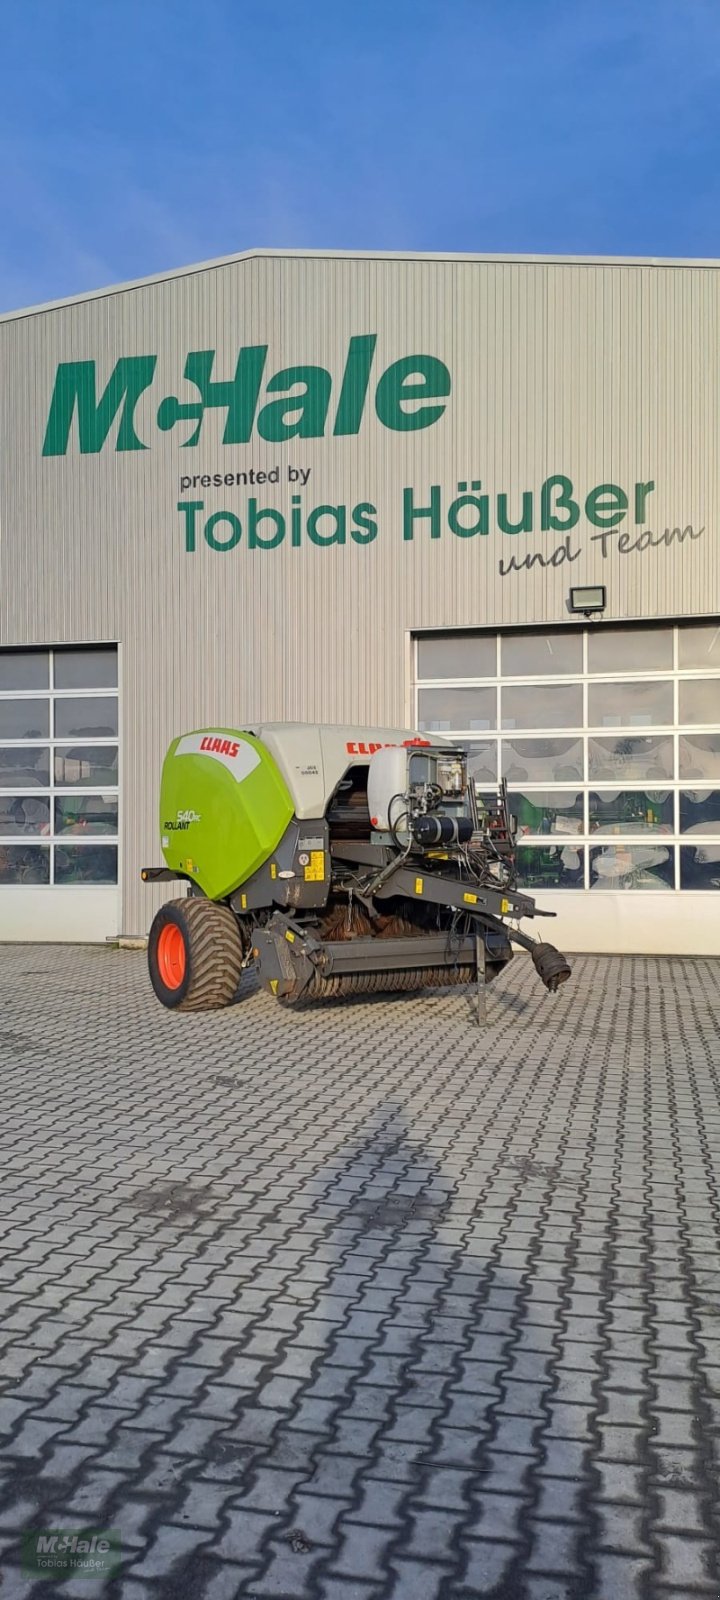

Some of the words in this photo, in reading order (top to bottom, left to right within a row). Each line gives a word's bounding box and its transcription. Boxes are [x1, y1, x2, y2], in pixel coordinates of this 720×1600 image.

[41, 333, 452, 457] McHale
[180, 466, 280, 493] presented
[288, 465, 312, 486] by
[177, 495, 379, 553] Tobias
[403, 474, 655, 541] Häußer
[499, 536, 582, 576] und
[590, 525, 706, 558] Team
[200, 736, 241, 758] CLAAS
[164, 821, 190, 831] ROLLANT
